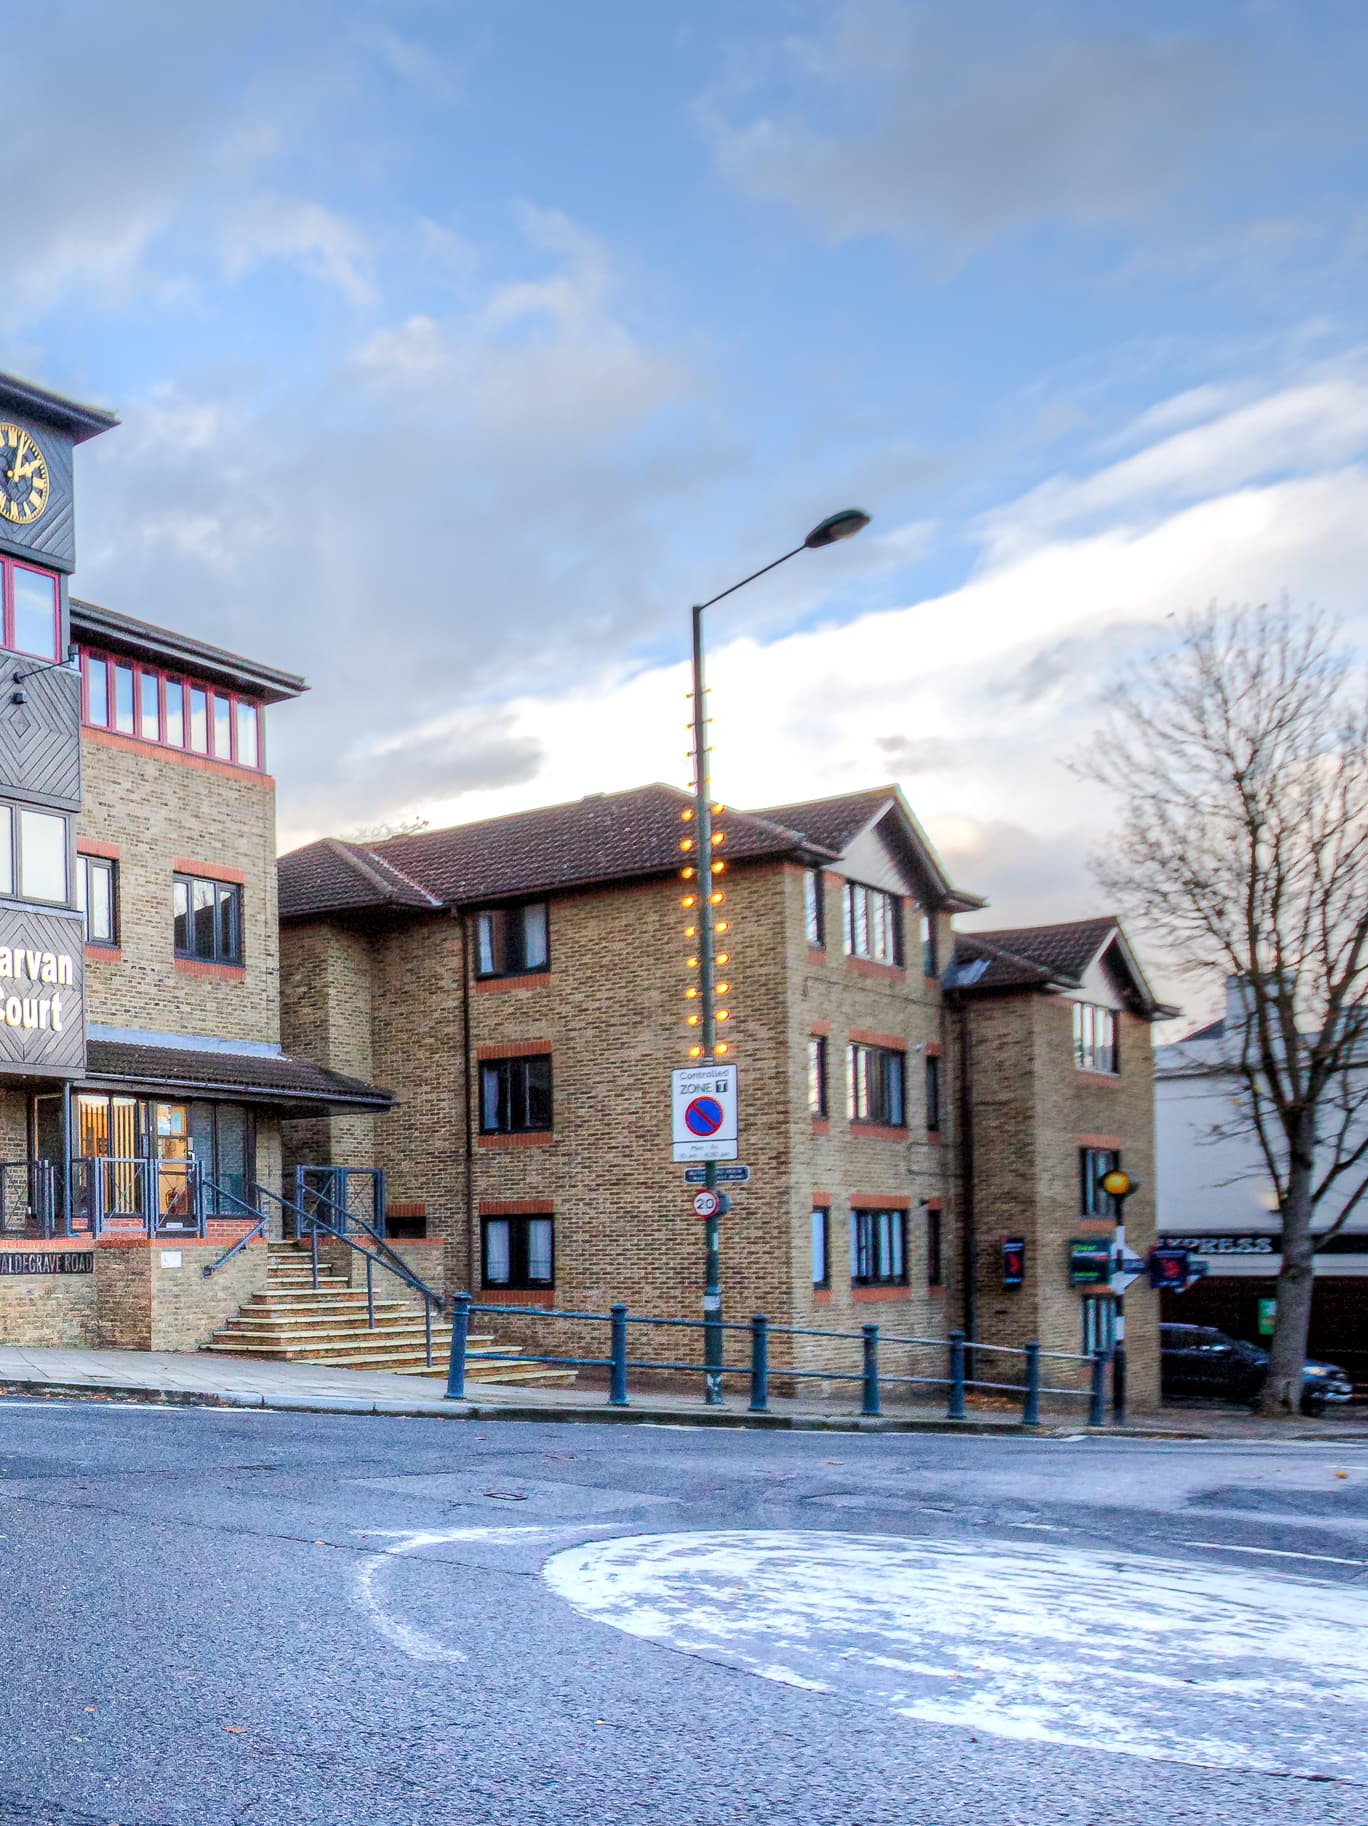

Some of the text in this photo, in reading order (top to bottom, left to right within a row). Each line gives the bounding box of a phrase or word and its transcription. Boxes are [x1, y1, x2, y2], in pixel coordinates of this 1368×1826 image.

[680, 1069, 729, 1080] Controlled
[680, 1082, 713, 1095] ZONE
[696, 1198, 714, 1209] 20
[64, 1253, 93, 1272] ROAD
